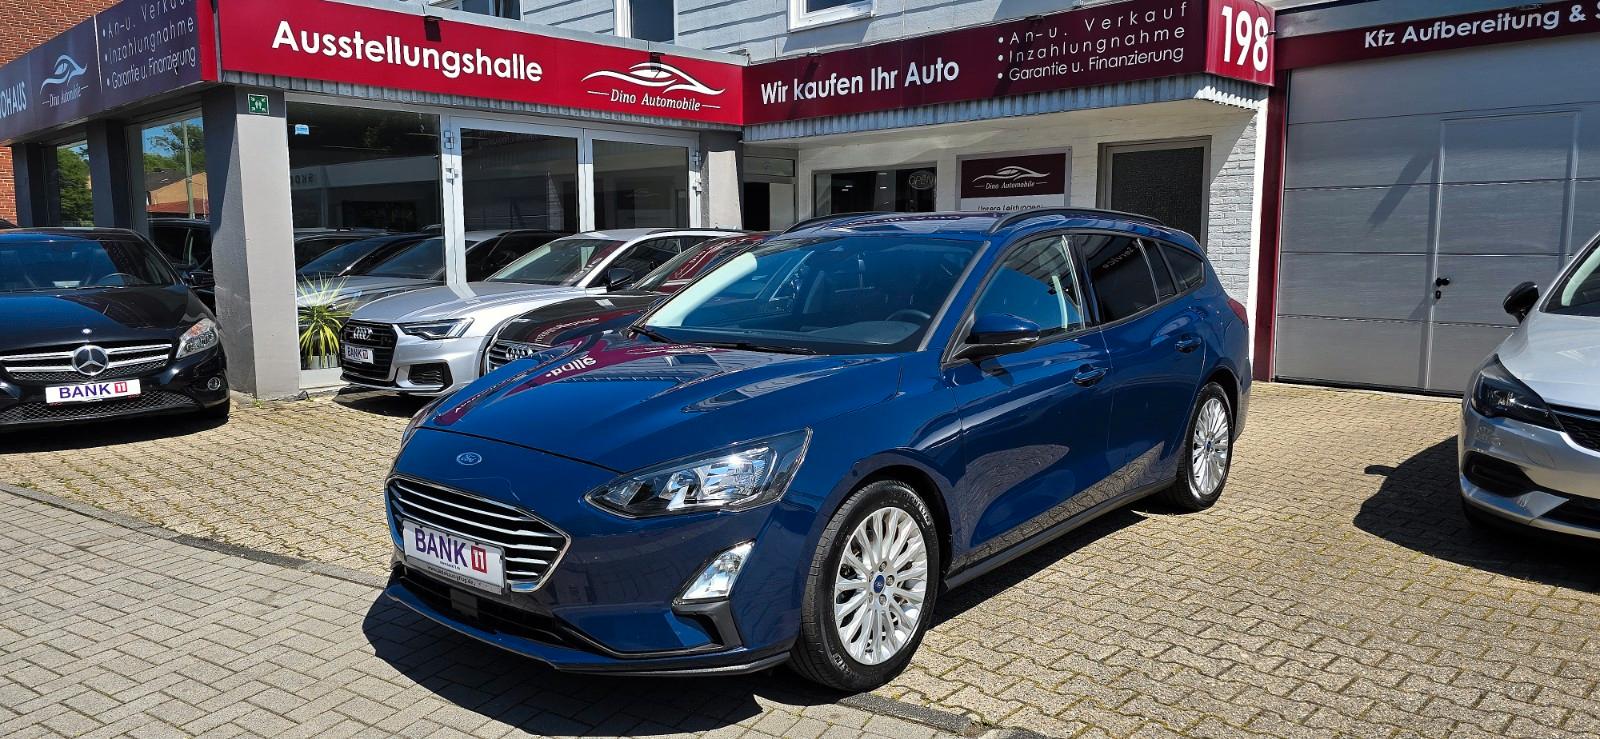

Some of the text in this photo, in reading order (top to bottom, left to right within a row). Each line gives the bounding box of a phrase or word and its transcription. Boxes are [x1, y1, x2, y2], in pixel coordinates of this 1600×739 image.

[1085, 2, 1187, 32] Verkauf
[1221, 5, 1269, 72] 198
[1364, 29, 1395, 48] Kfz
[1401, 9, 1560, 44] Aufbereitung
[1568, 4, 1587, 23] &
[109, 17, 194, 64] Inzahlungnahme
[271, 20, 543, 82] Ausstellungshalle
[1009, 26, 1185, 63] Inzahlungnahme
[112, 64, 140, 89] Garantie
[148, 46, 196, 77] Finanzierung
[760, 57, 960, 105] Wir kaufen Ihr Auto
[1009, 47, 1184, 81] Garantie u. Finanzierung
[610, 88, 701, 112] Dino Automobile
[985, 180, 1035, 190] Dino Automobile
[59, 383, 111, 398] BANK
[115, 381, 127, 393] 11
[414, 527, 486, 573] BANK 11
